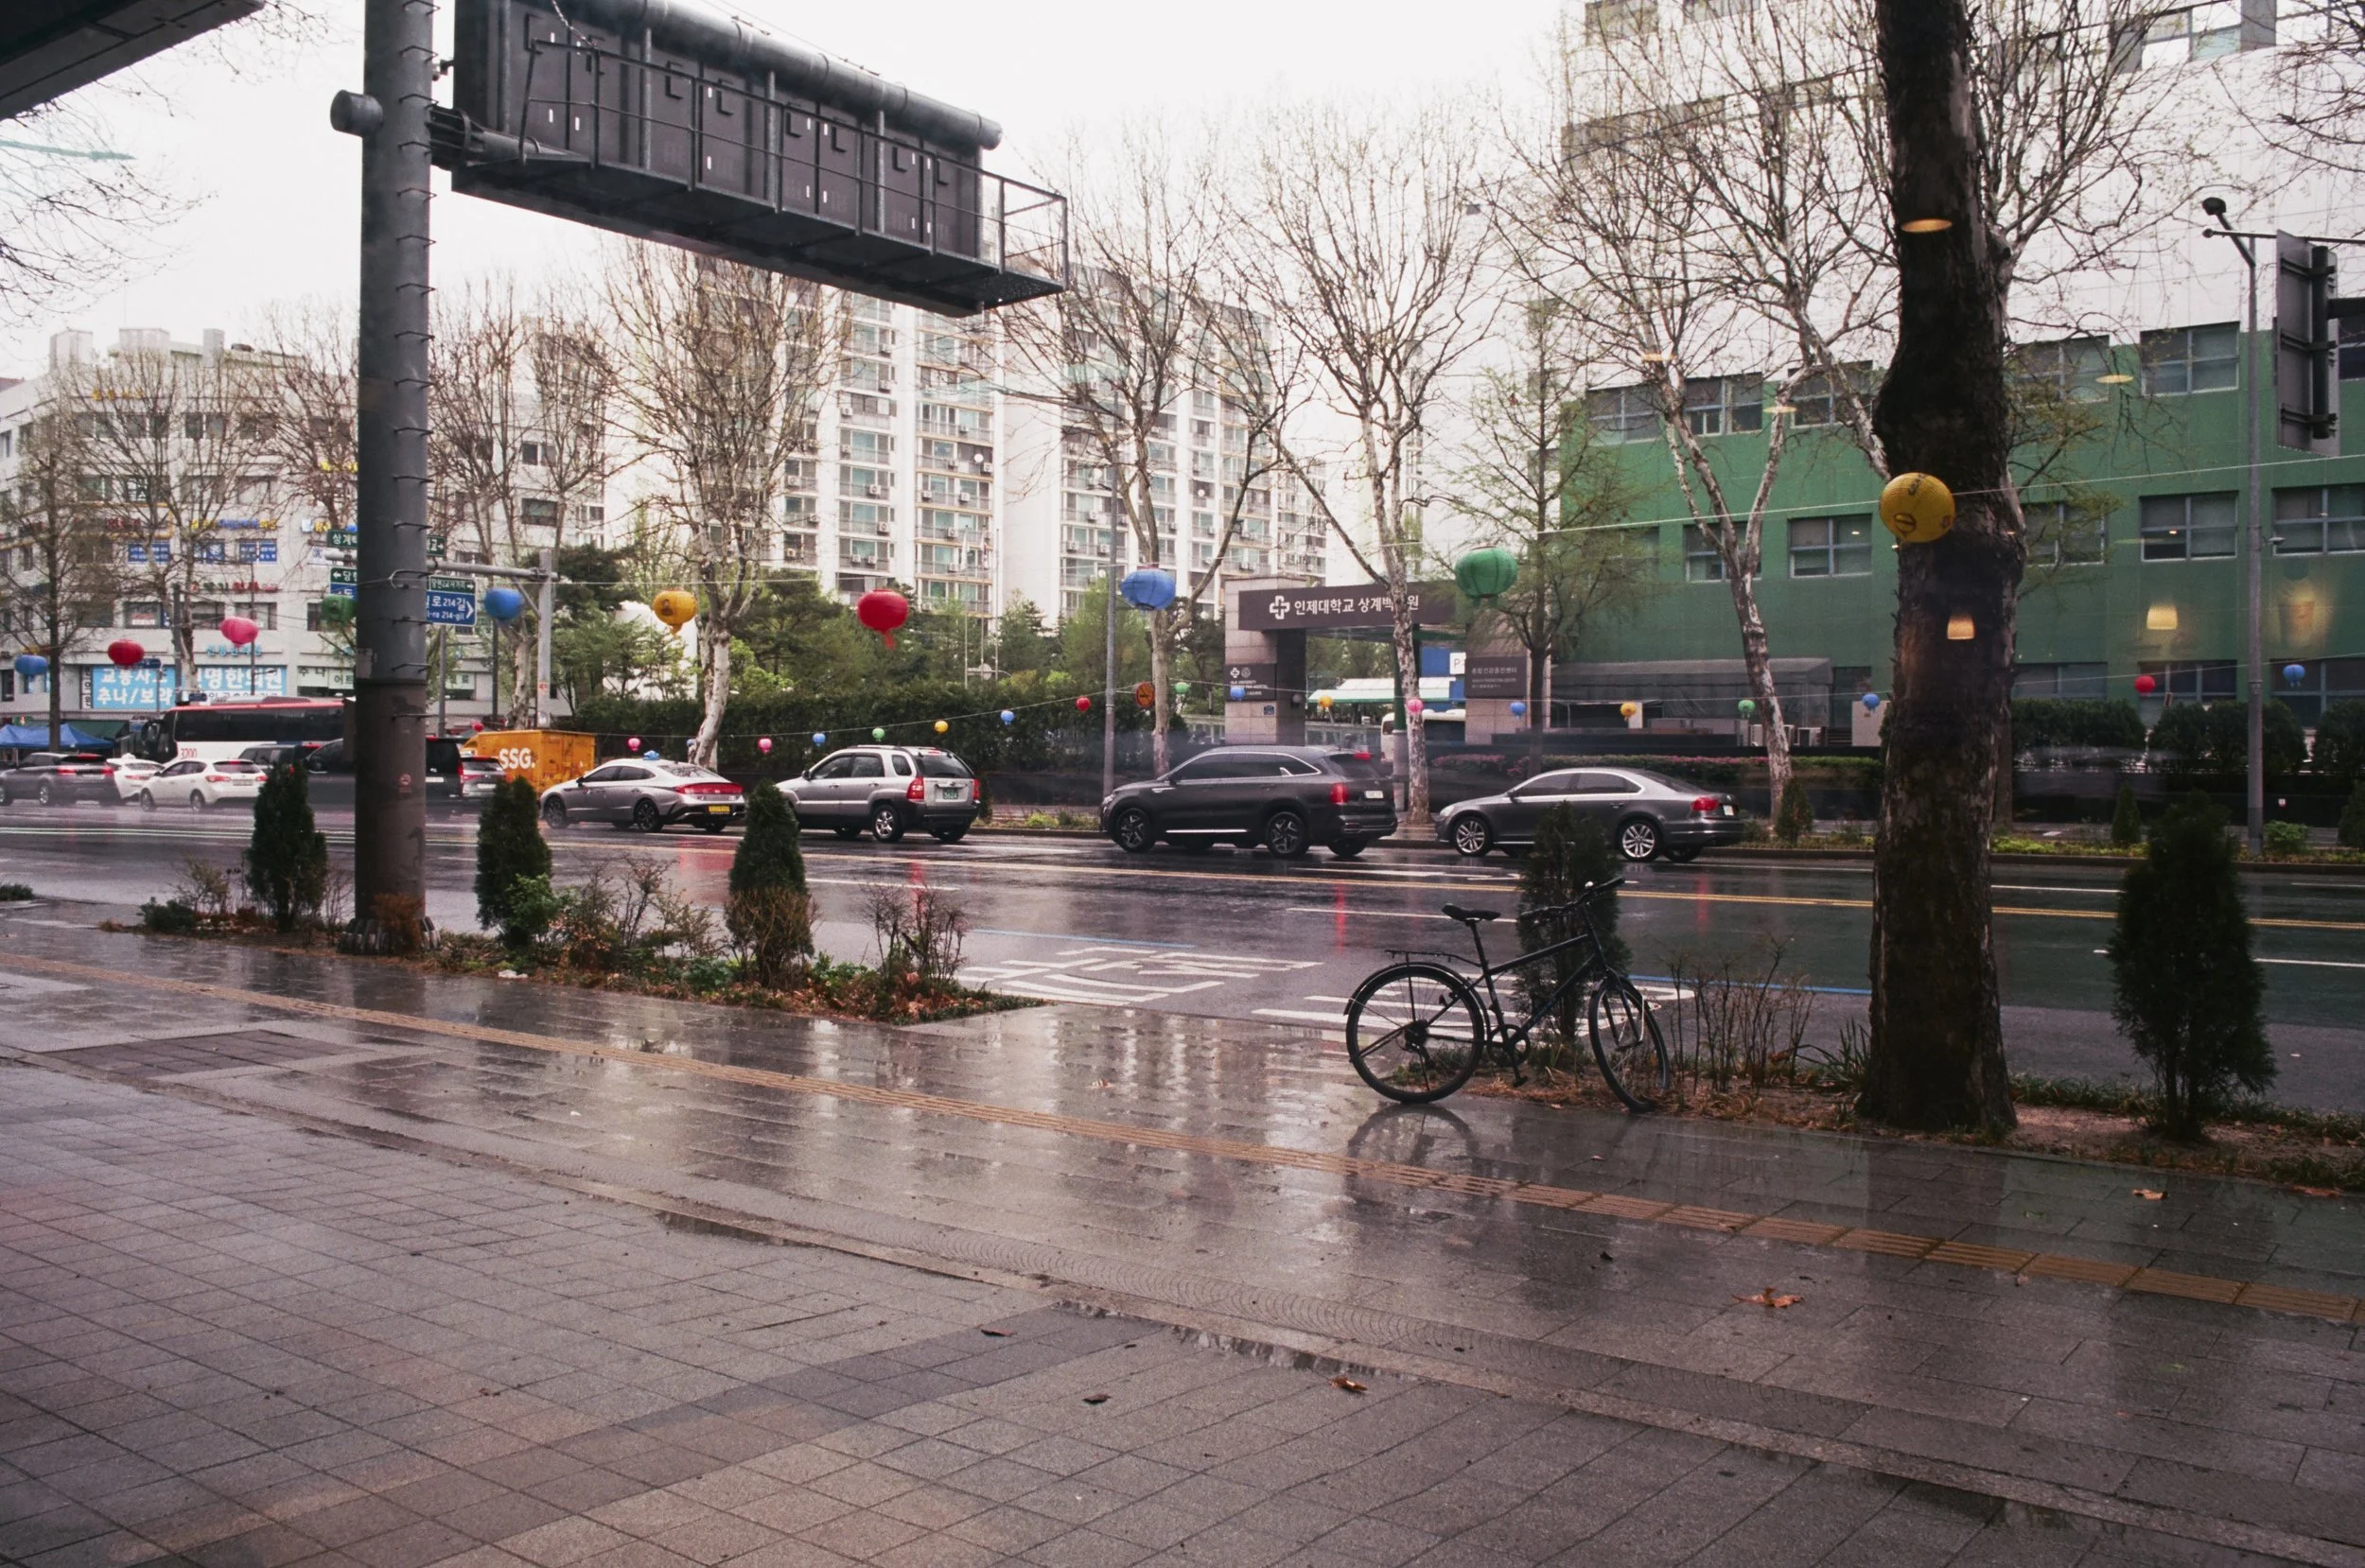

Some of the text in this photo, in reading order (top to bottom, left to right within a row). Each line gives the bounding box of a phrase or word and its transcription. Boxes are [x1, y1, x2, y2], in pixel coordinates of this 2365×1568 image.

[1294, 595, 1419, 616] 인제대학교 상계백원
[499, 747, 536, 770] SSG.
